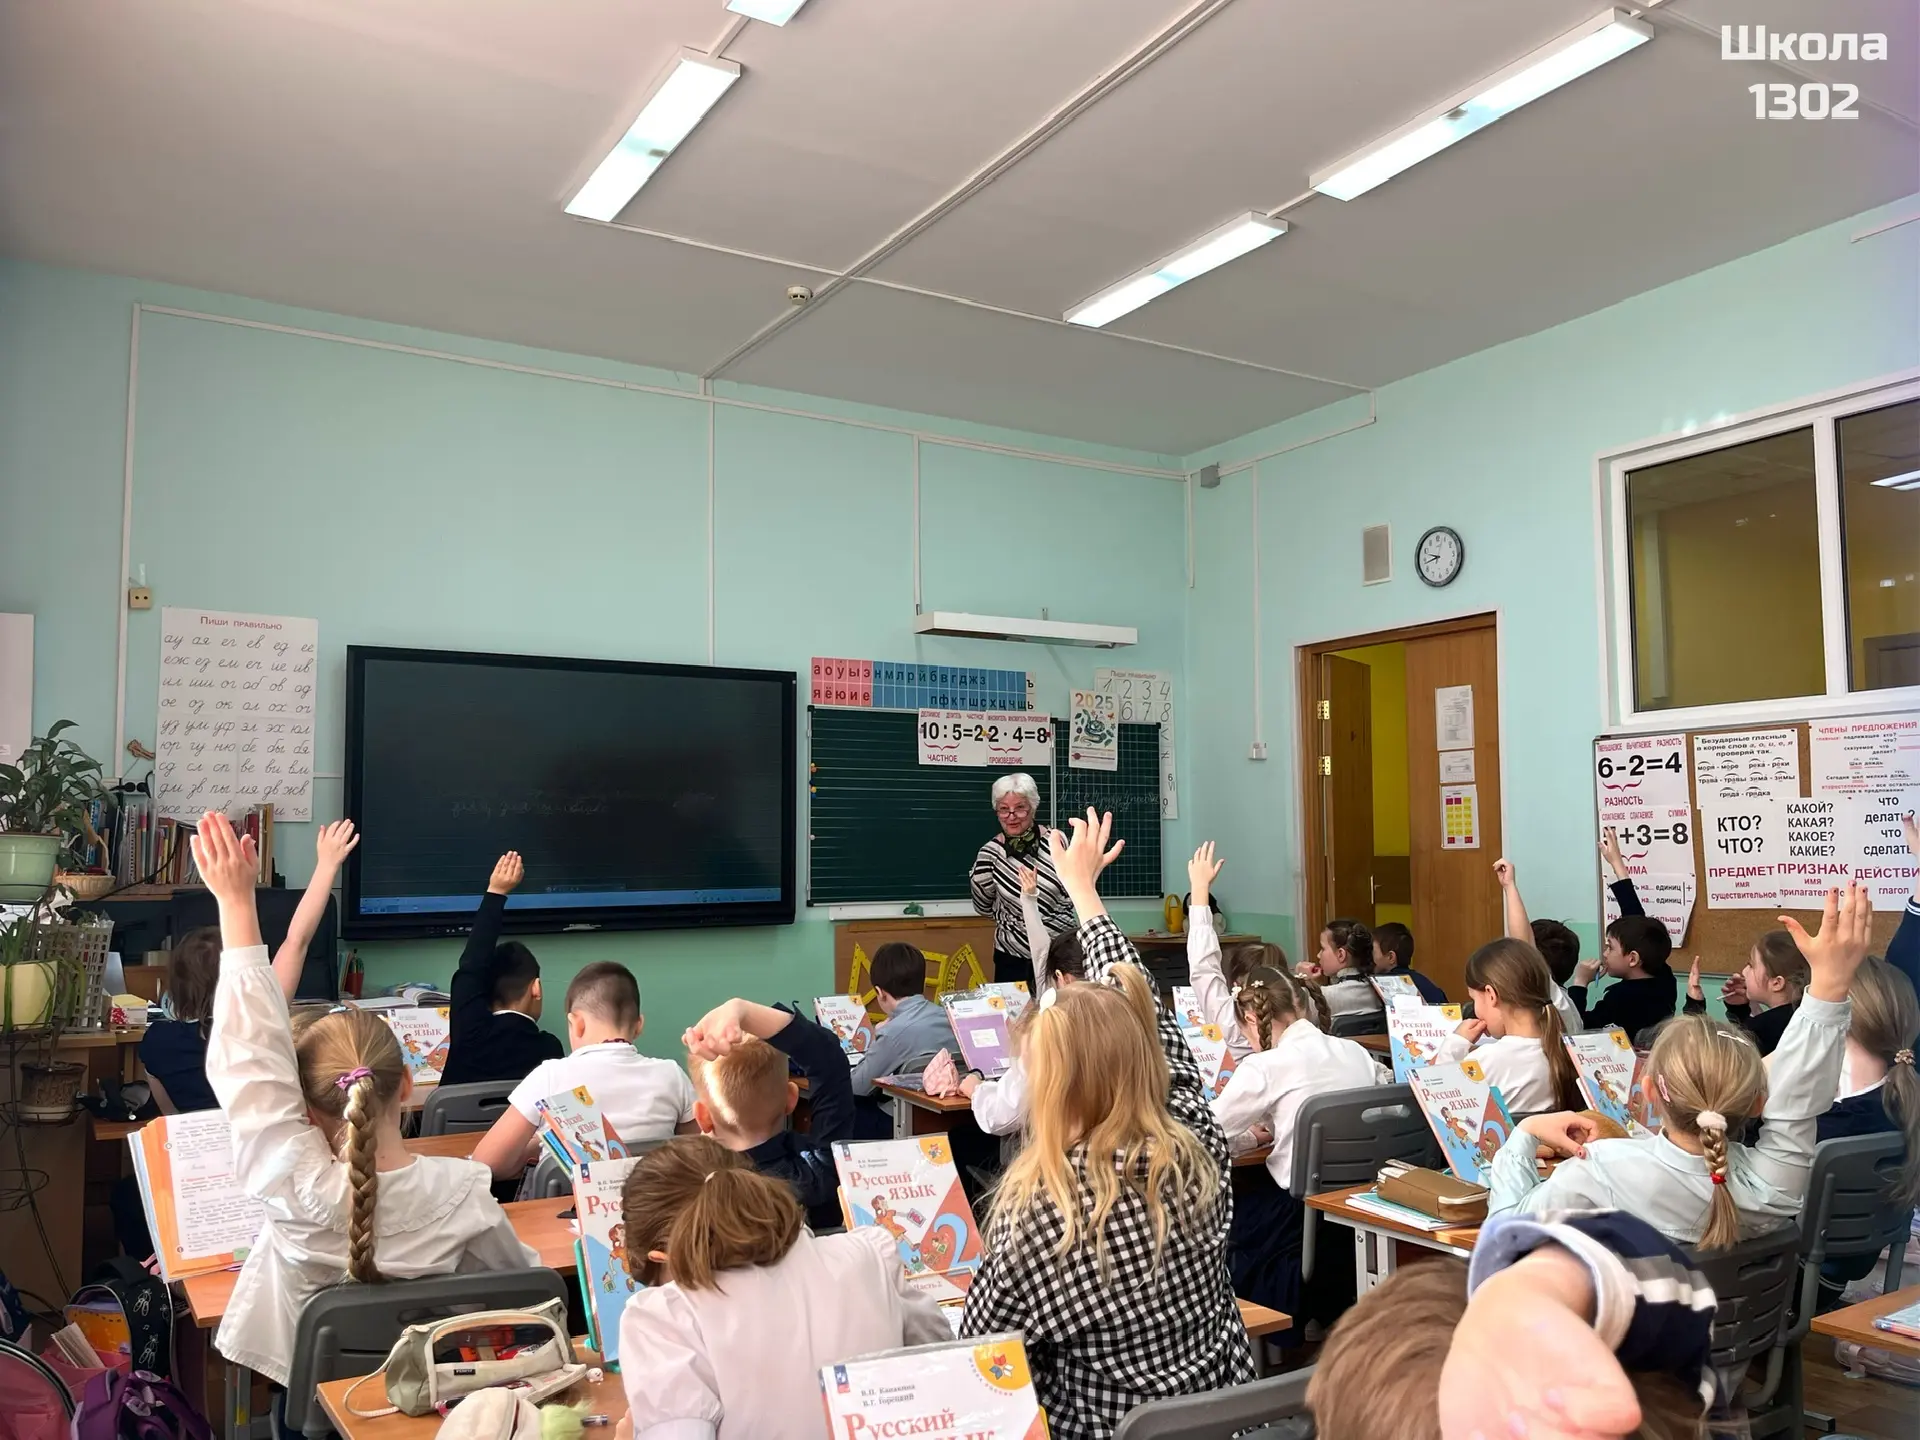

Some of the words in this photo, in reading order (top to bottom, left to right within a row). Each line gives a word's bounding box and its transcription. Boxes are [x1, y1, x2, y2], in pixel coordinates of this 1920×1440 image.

[200, 616, 228, 626] Пиши
[234, 620, 283, 630] правильно
[164, 634, 184, 650] ау
[192, 636, 211, 645] ая
[246, 634, 265, 648] ев
[273, 642, 289, 657] ед
[301, 643, 314, 652] ее
[164, 655, 190, 664] еж
[218, 659, 240, 668] ем
[271, 662, 287, 671] ие
[293, 657, 314, 673] ив
[242, 675, 268, 690] об
[269, 677, 288, 691] ов
[294, 684, 312, 699] од
[1122, 679, 1132, 699] 2
[1142, 680, 1152, 700] 3
[1160, 681, 1171, 701] 4
[161, 698, 176, 707] ое
[188, 698, 205, 714] оз
[268, 702, 287, 712] ох
[1075, 692, 1114, 711] 2025
[1122, 701, 1133, 720] 6
[1142, 701, 1152, 721] 7
[1160, 703, 1171, 722] 8
[161, 719, 180, 735] уз
[184, 720, 210, 736] ум
[212, 721, 236, 737] уф
[241, 722, 258, 732] эл
[265, 724, 285, 734] эх
[291, 724, 310, 734] юл
[1818, 725, 1848, 734] ЧЛЕНЫ
[1851, 721, 1918, 733] ПРЕДЛОЖЕНИЯ
[1656, 738, 1682, 746] РАЗНОСТЬ
[1701, 736, 1750, 745] Безударные
[1752, 733, 1788, 742] гласные
[213, 742, 236, 752] ню
[242, 737, 259, 753] бе
[267, 738, 286, 754] бы
[293, 740, 310, 755] бя
[1703, 744, 1726, 752] корне
[927, 754, 958, 763] ЧАСТНОЕ
[1715, 749, 1755, 757] проверяй
[159, 762, 176, 777] сд
[186, 762, 203, 771] сл
[240, 757, 255, 773] ве
[265, 758, 282, 774] ви
[288, 760, 310, 775] вм
[1598, 751, 1682, 779] 6-2=4
[186, 777, 208, 799] зв
[209, 783, 232, 794] пы
[235, 784, 259, 795] мя
[262, 779, 283, 801] дв
[283, 780, 307, 796] жв
[1604, 796, 1644, 806] РАЗНОСТЬ
[1786, 801, 1834, 814] КАКОЙ?
[1878, 797, 1899, 806] что
[158, 804, 180, 814] же
[1668, 809, 1688, 818] СУММА
[1717, 814, 1762, 832] КТО?
[1787, 817, 1834, 828] КАКАЯ?
[1788, 831, 1835, 842] КАКОЕ?
[1881, 829, 1902, 839] что
[1717, 836, 1764, 854] ЧТО?
[1789, 845, 1836, 857] КАКИЕ?
[1709, 865, 1775, 878] ПРЕДМЕТ
[1777, 863, 1849, 875] ПРИЗНАК
[1655, 883, 1682, 892] единиц
[1804, 878, 1822, 886] имя
[1711, 891, 1777, 900] существительное
[1878, 887, 1909, 896] глагол
[1655, 897, 1682, 905] единиц
[393, 1021, 430, 1030] Русский
[1392, 1019, 1433, 1031] Русский
[1576, 1053, 1612, 1068] Русский
[1421, 1086, 1463, 1103] Русский
[553, 1112, 585, 1130] Русский
[849, 1171, 913, 1190] Русский
[842, 1408, 956, 1440] Русский
